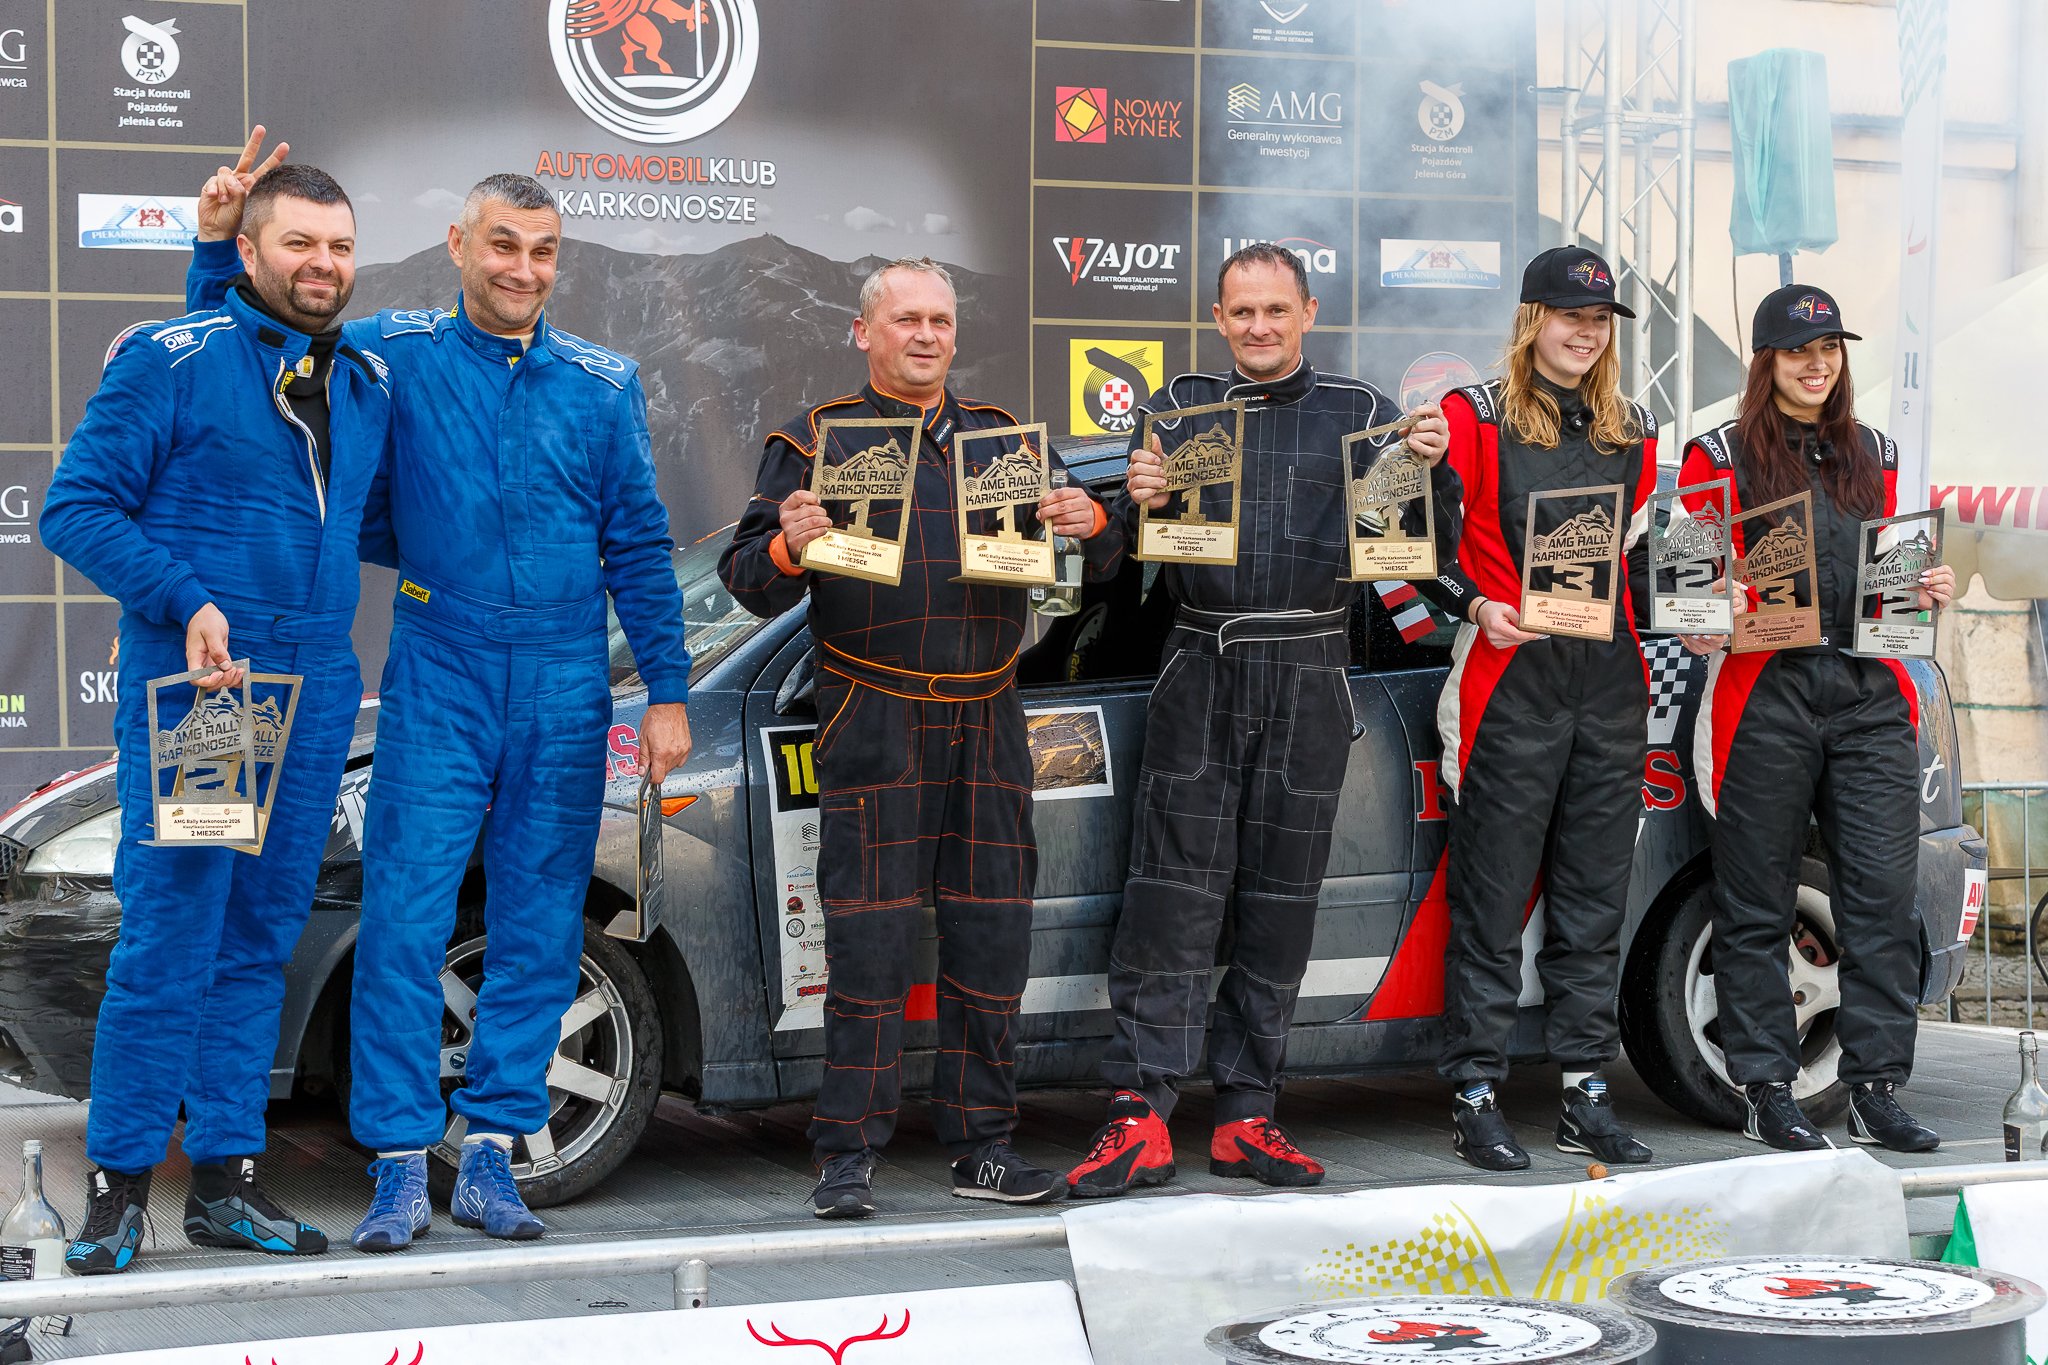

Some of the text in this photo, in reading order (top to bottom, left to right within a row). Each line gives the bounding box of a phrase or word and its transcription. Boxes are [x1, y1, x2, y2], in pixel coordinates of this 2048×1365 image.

[136, 68, 166, 83] PZM
[113, 87, 191, 100] Stacja Kontroli
[127, 102, 178, 114] Pojazdów
[1114, 99, 1182, 119] NOWY
[1266, 90, 1342, 122] AMG
[119, 115, 183, 128] Jelenia Góra
[1114, 118, 1182, 138] RYNEK
[1227, 129, 1342, 145] Generalny wykonawca
[1429, 127, 1454, 139] PZM
[1260, 146, 1310, 158] inwestycji
[1411, 143, 1473, 154] Stacja Kontroli
[535, 151, 777, 187] AUTOMOBILKLUB
[1414, 169, 1466, 180] Jelenia Góra
[558, 190, 757, 223] KARKONOSZE
[1093, 275, 1177, 284] ELEKTROINSTALATORSTWO
[1113, 284, 1158, 292] www.ajotnet.pl
[164, 332, 195, 349] OMP
[1464, 387, 1490, 418] sparco
[1098, 411, 1137, 431] PZM
[1699, 435, 1726, 462] sparco
[1166, 453, 1234, 473] AMG RALLY
[837, 470, 907, 482] AMG RALLY
[980, 474, 1043, 492] AMG RALLY
[1167, 467, 1231, 487] RKONOSZE
[819, 484, 903, 495] KARKONOSZE
[966, 487, 1041, 506] KARKONOSZE
[1548, 533, 1613, 549] AMG RALLY
[1532, 547, 1609, 562] KARKONOSZE
[1748, 541, 1807, 569] AMG RALLY
[998, 565, 1024, 573] MIEJSCE
[1878, 564, 1902, 576] AMG
[404, 582, 427, 601] Sabelt
[1556, 621, 1583, 629] MIEJSCE
[0, 717, 27, 728] NIA
[174, 718, 244, 746] AMG RALLY
[252, 731, 283, 744] ALLY
